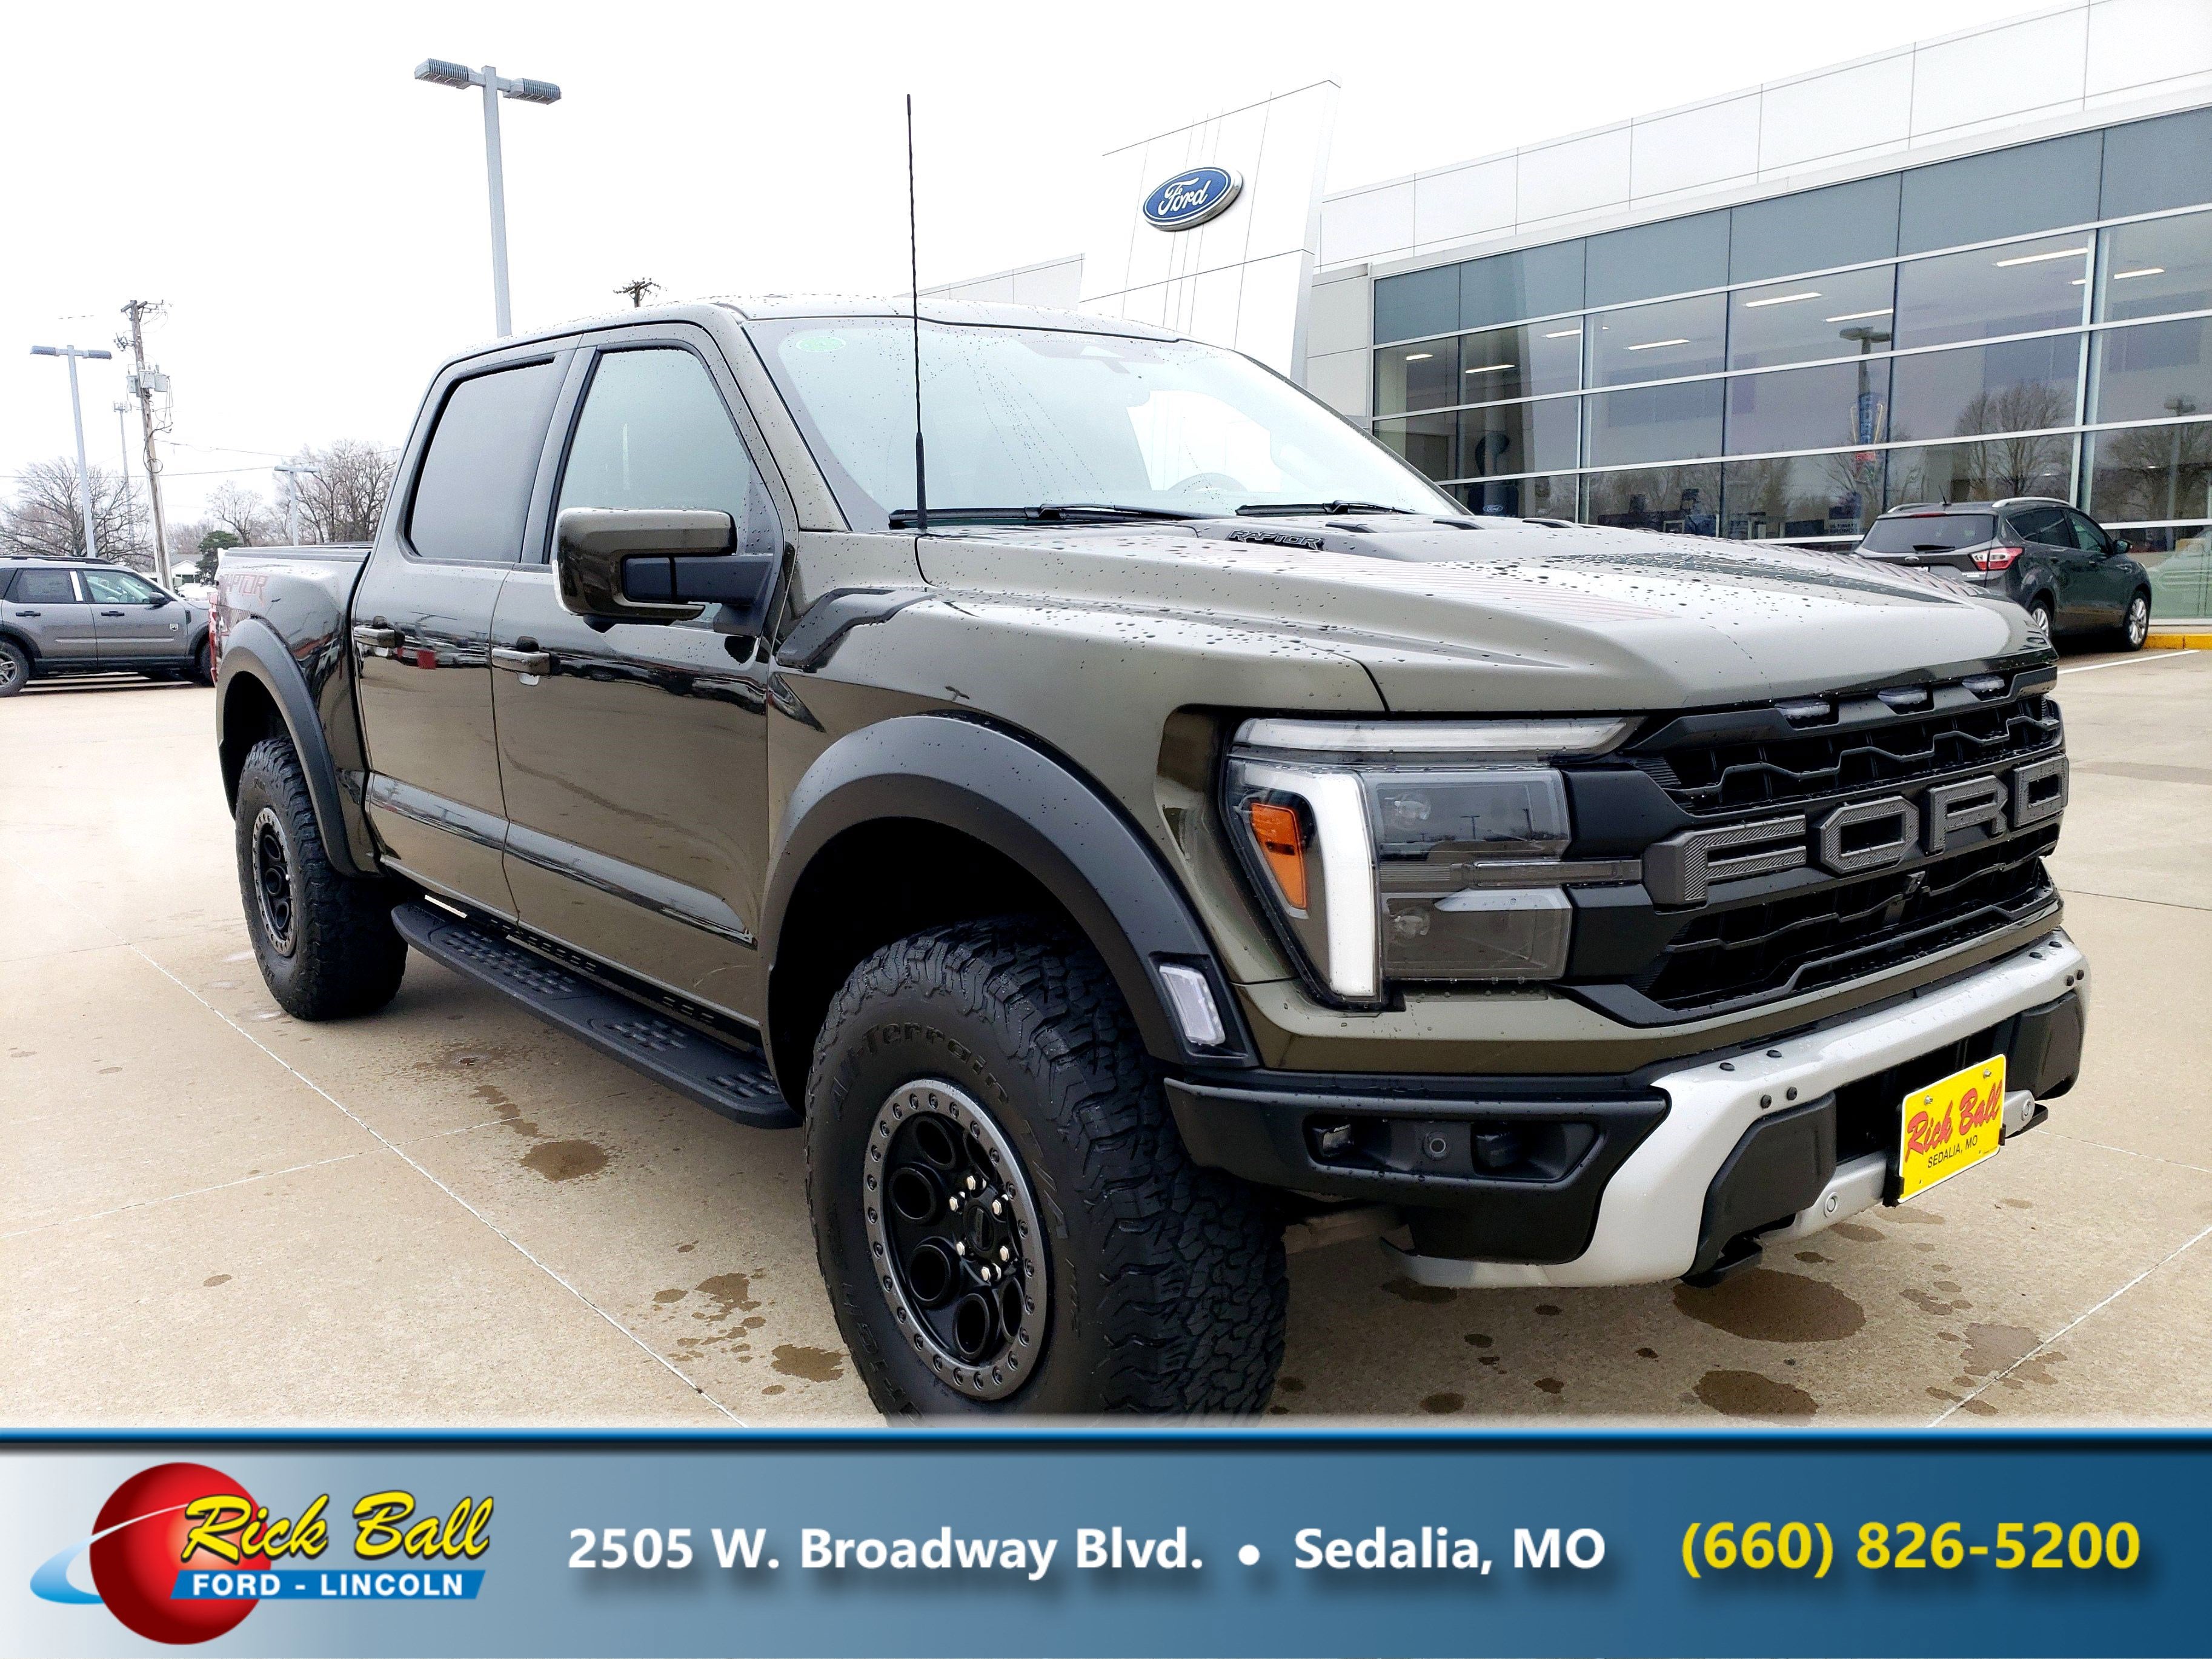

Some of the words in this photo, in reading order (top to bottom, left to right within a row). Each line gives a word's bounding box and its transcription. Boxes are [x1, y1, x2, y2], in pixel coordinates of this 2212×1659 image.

[1158, 177, 1212, 216] Ford
[1229, 530, 1324, 551] RAPTOR
[1648, 753, 2069, 913] FORD
[1905, 1100, 1953, 1163] Rick
[1959, 1079, 2004, 1136] Ball
[1927, 1143, 1964, 1169] SEDALIA,
[1965, 1134, 1979, 1152] MO
